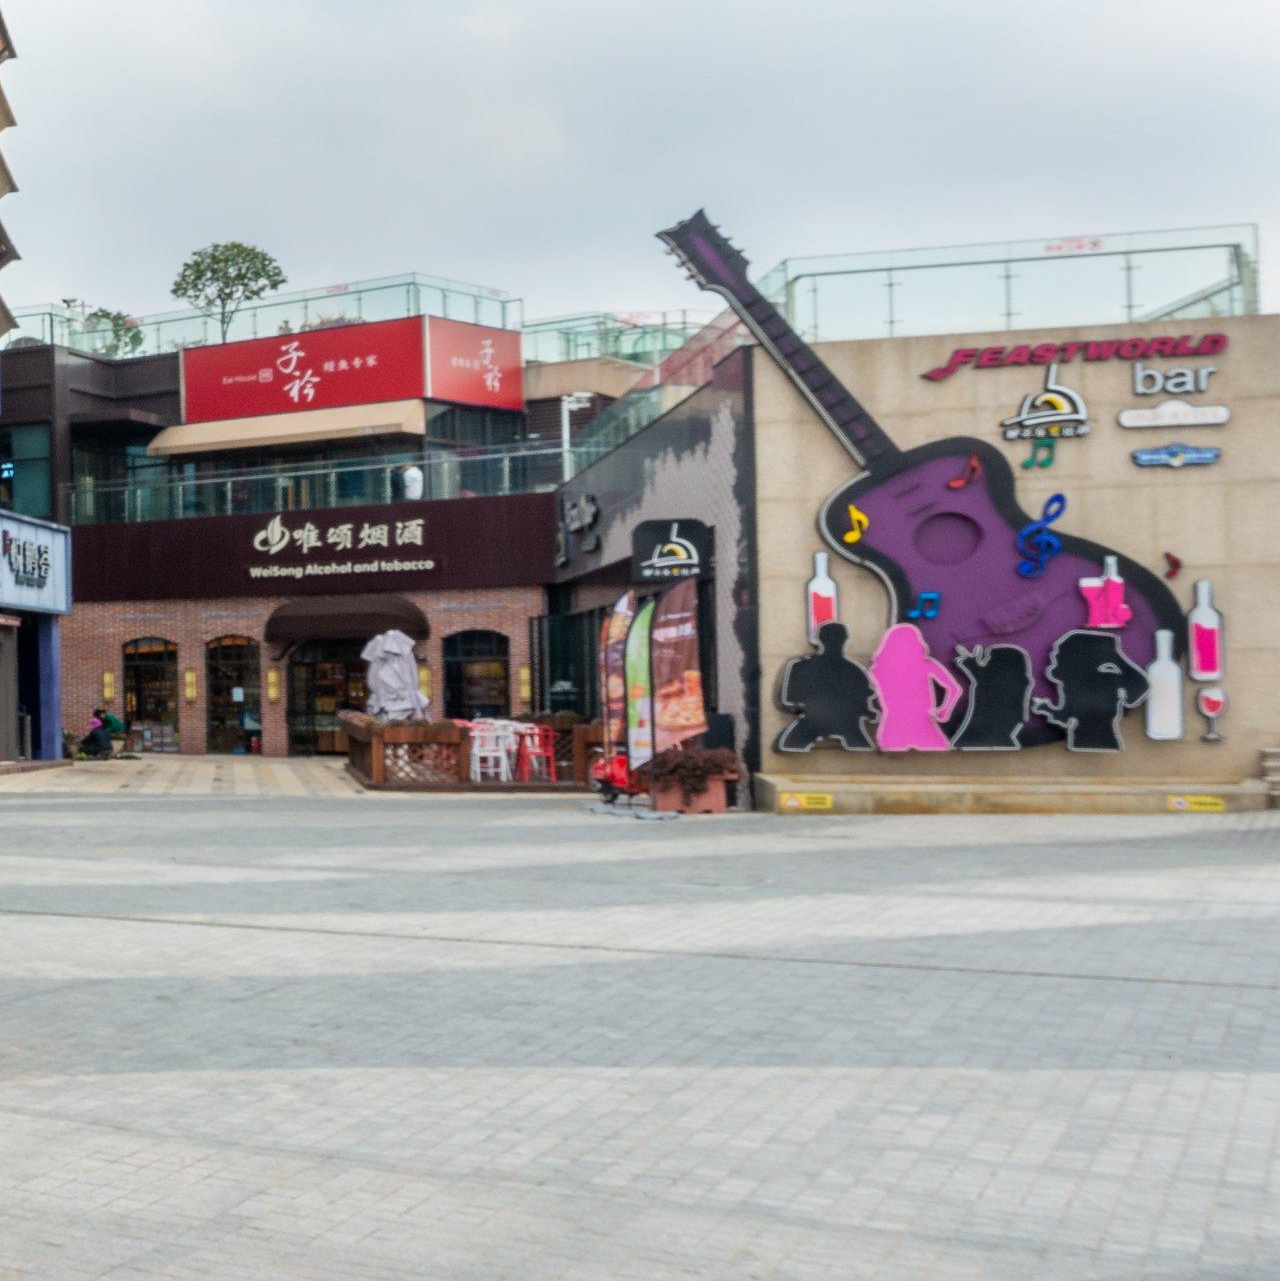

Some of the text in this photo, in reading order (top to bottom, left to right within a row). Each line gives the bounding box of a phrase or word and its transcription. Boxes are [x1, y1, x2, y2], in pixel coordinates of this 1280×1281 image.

[1133, 363, 1220, 396] bar
[304, 562, 352, 576] Alcohol
[353, 561, 379, 574] and
[380, 559, 435, 572] tobacco
